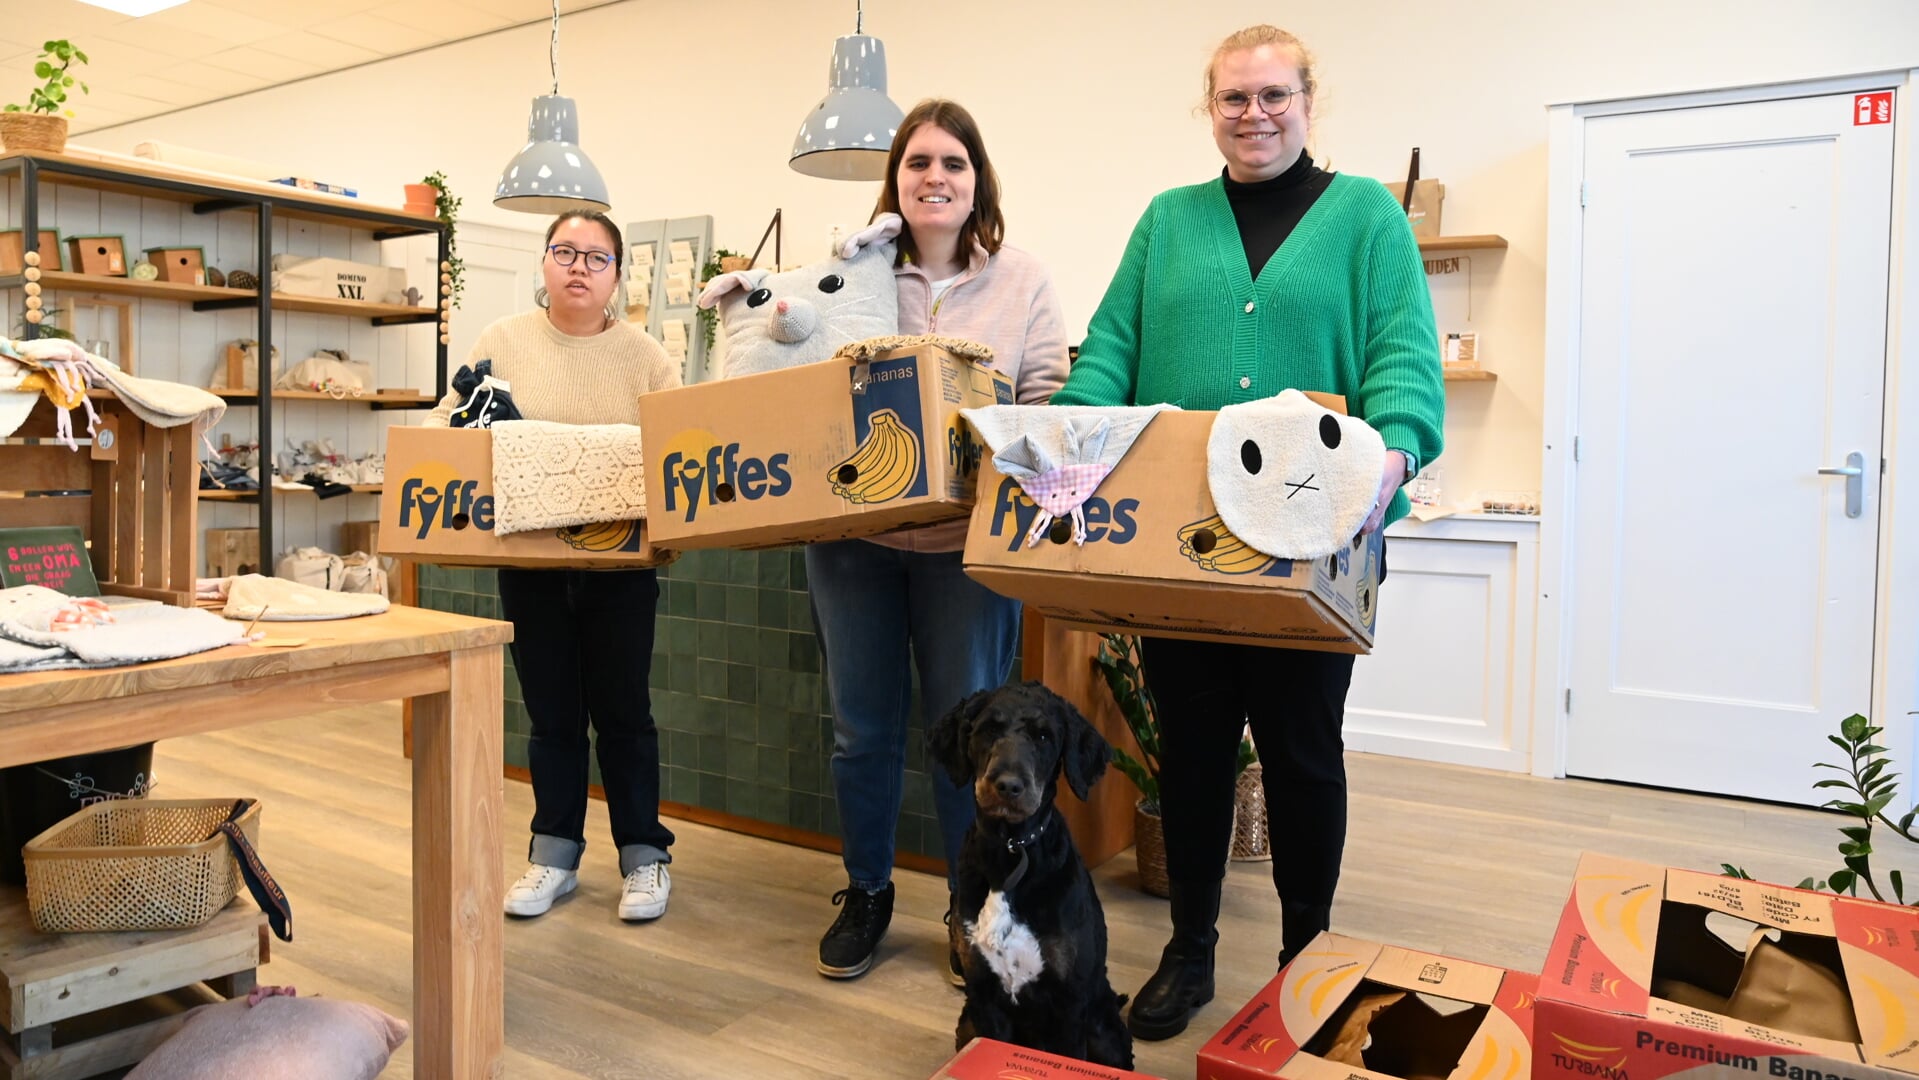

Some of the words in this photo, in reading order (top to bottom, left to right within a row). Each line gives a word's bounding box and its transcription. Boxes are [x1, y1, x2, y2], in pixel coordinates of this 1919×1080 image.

[1423, 256, 1459, 275] UDEN
[337, 272, 366, 283] DOMINO
[337, 284, 365, 301] XXL
[867, 366, 913, 385] ananas
[663, 443, 792, 523] fyffes
[399, 478, 495, 539] fyffe
[990, 476, 1140, 552] fyes
[7, 547, 19, 560] 6
[42, 553, 80, 569] OMA
[1013, 1052, 1064, 1069] Bananas
[1636, 1031, 1758, 1072] Premium
[1552, 1053, 1630, 1080] TURBANA
